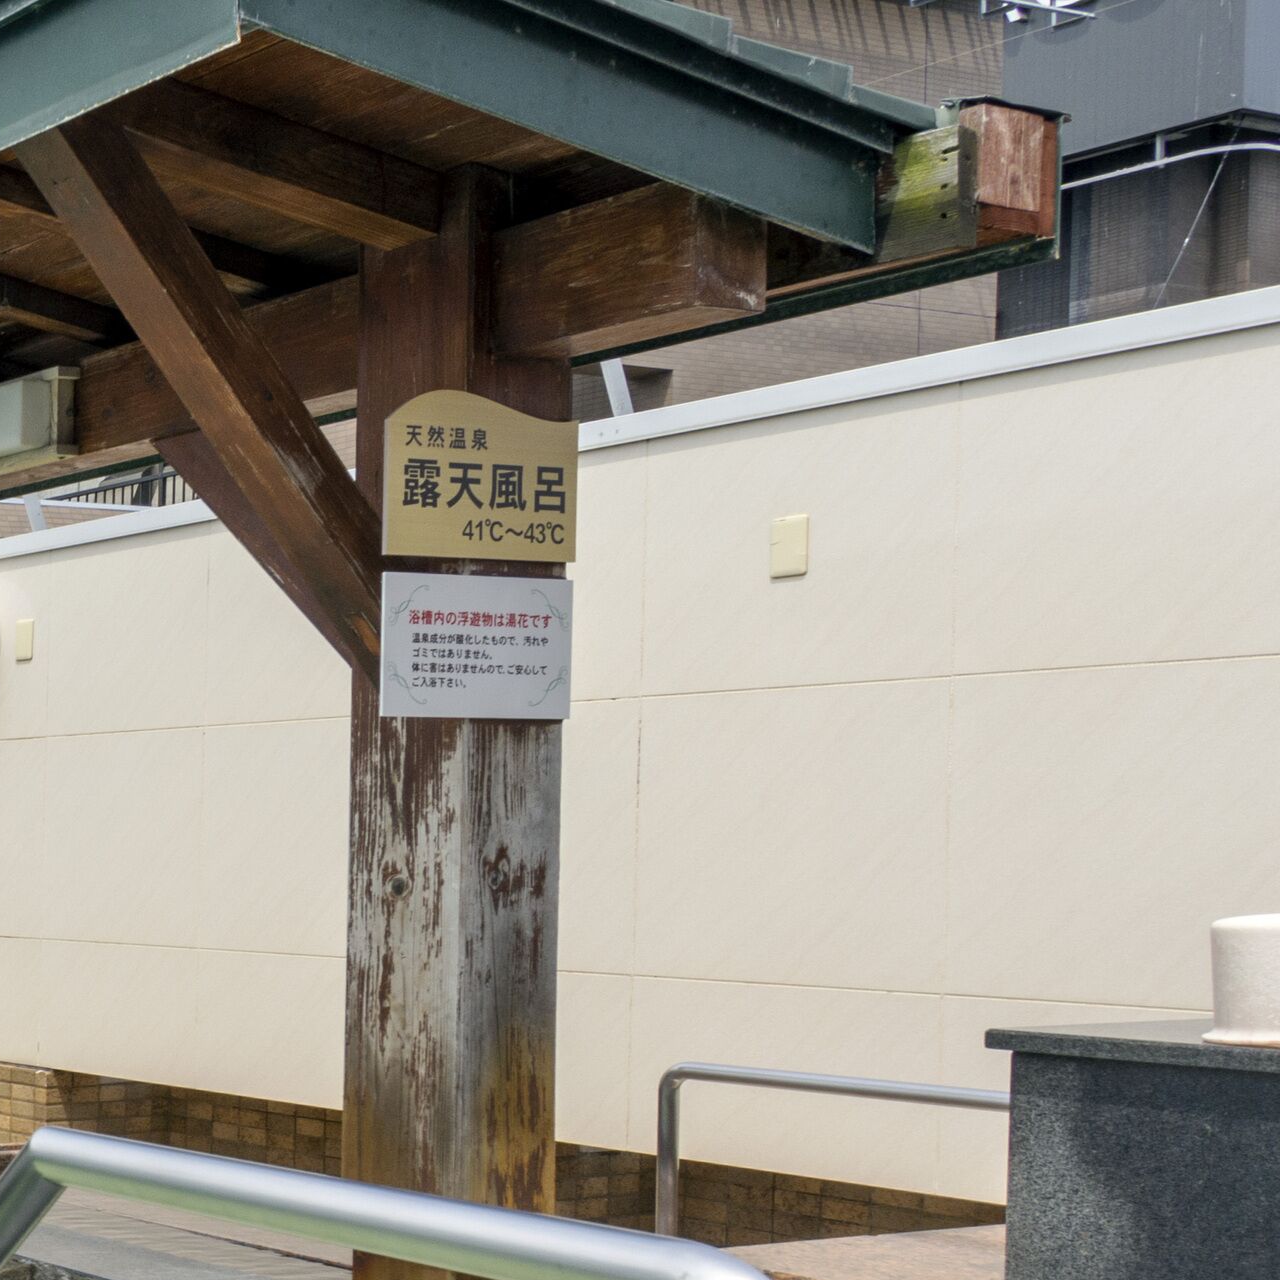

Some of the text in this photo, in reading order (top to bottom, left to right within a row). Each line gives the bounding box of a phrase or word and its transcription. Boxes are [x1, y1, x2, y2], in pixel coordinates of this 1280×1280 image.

[405, 424, 488, 451] 天然温泉
[402, 458, 567, 514] 露天風呂
[408, 609, 552, 629] 浴槽内の浮遊物は湯花です
